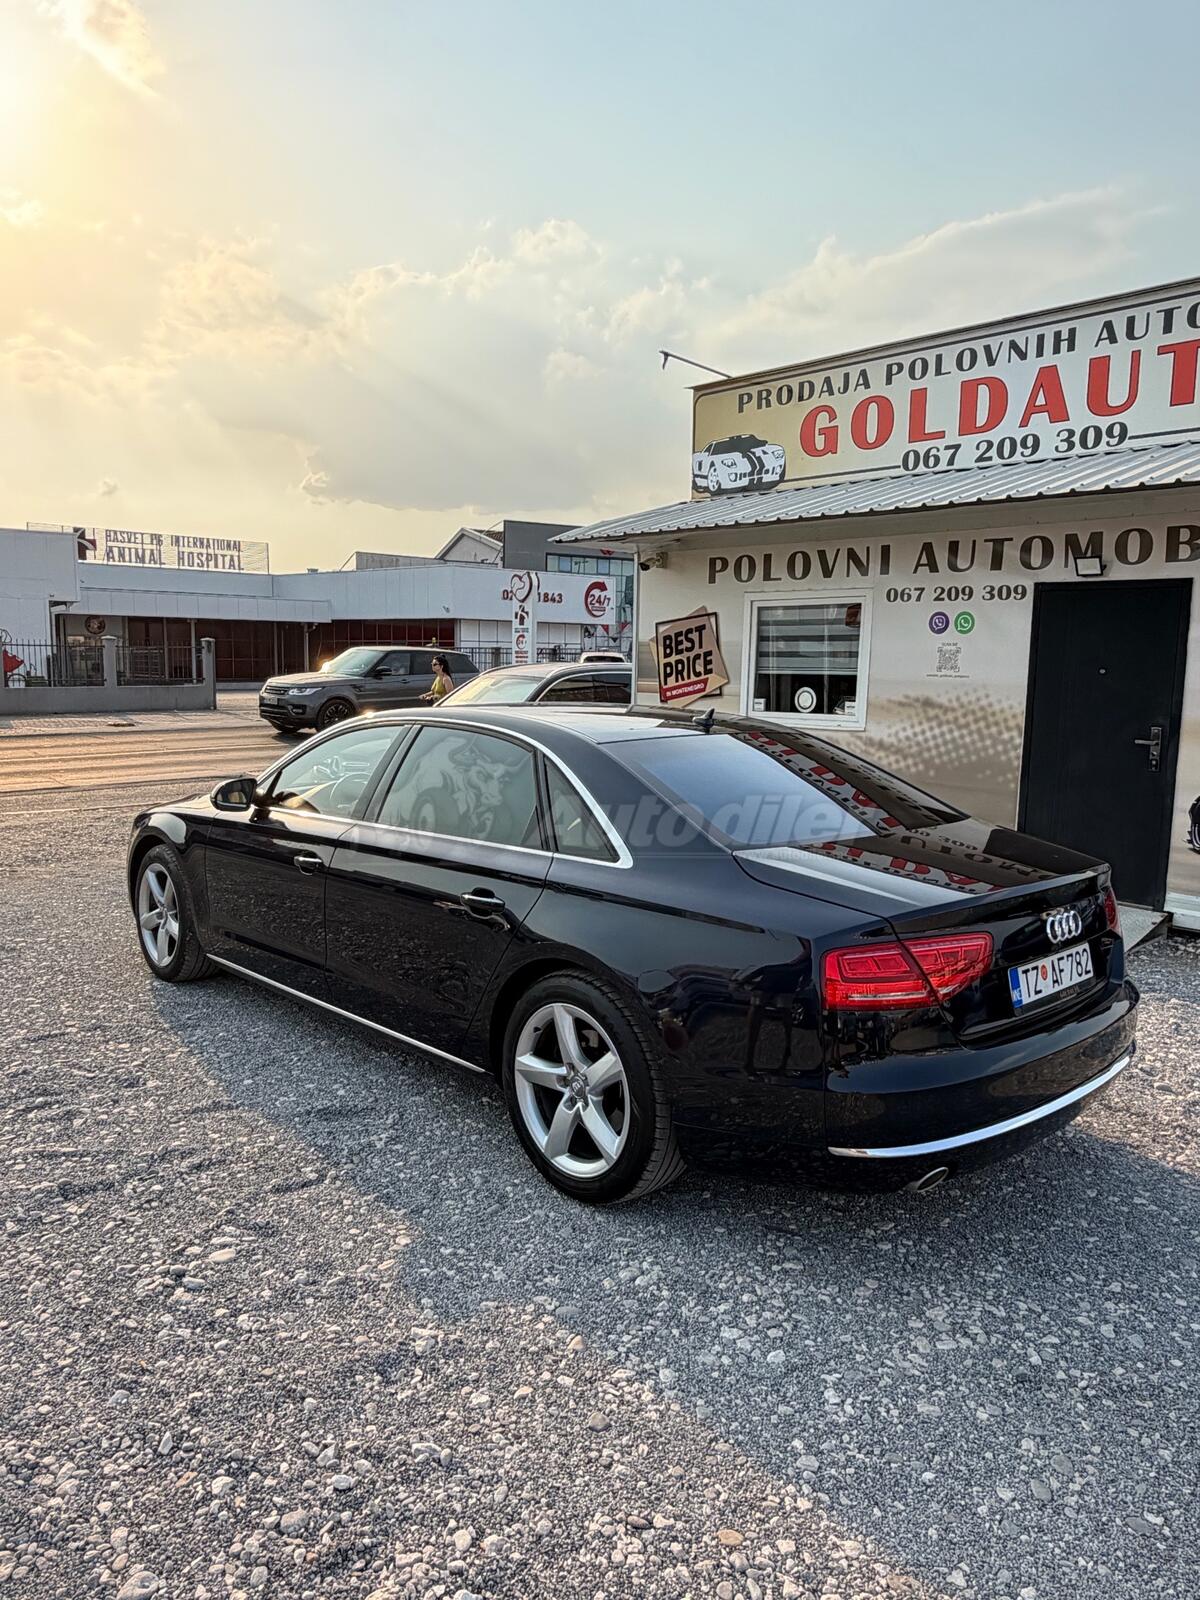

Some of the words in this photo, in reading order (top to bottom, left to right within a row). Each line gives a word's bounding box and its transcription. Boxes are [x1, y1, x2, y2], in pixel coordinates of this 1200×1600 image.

[738, 368, 871, 413] PRODAJA
[885, 326, 1077, 387] POLOVNIH
[799, 339, 1200, 459] GOLDAUT
[901, 444, 961, 473] 067
[973, 432, 1041, 464] 209
[1053, 421, 1129, 454] 309
[104, 546, 166, 566] ANIMAL
[177, 550, 244, 571] HOSPITAL
[170, 535, 244, 552] INTERNATIONAL
[708, 543, 891, 585] POLOVNI
[912, 524, 1200, 574] AUTOMOB
[589, 594, 611, 607] 24/7
[886, 587, 926, 603] 067
[933, 585, 974, 602] 209
[982, 584, 1028, 601] 309
[662, 623, 706, 659] BEST
[662, 650, 714, 686] PRICE
[671, 682, 705, 696] MONTENEGRO
[1022, 965, 1043, 998] TZ
[1051, 948, 1092, 989] AF782
